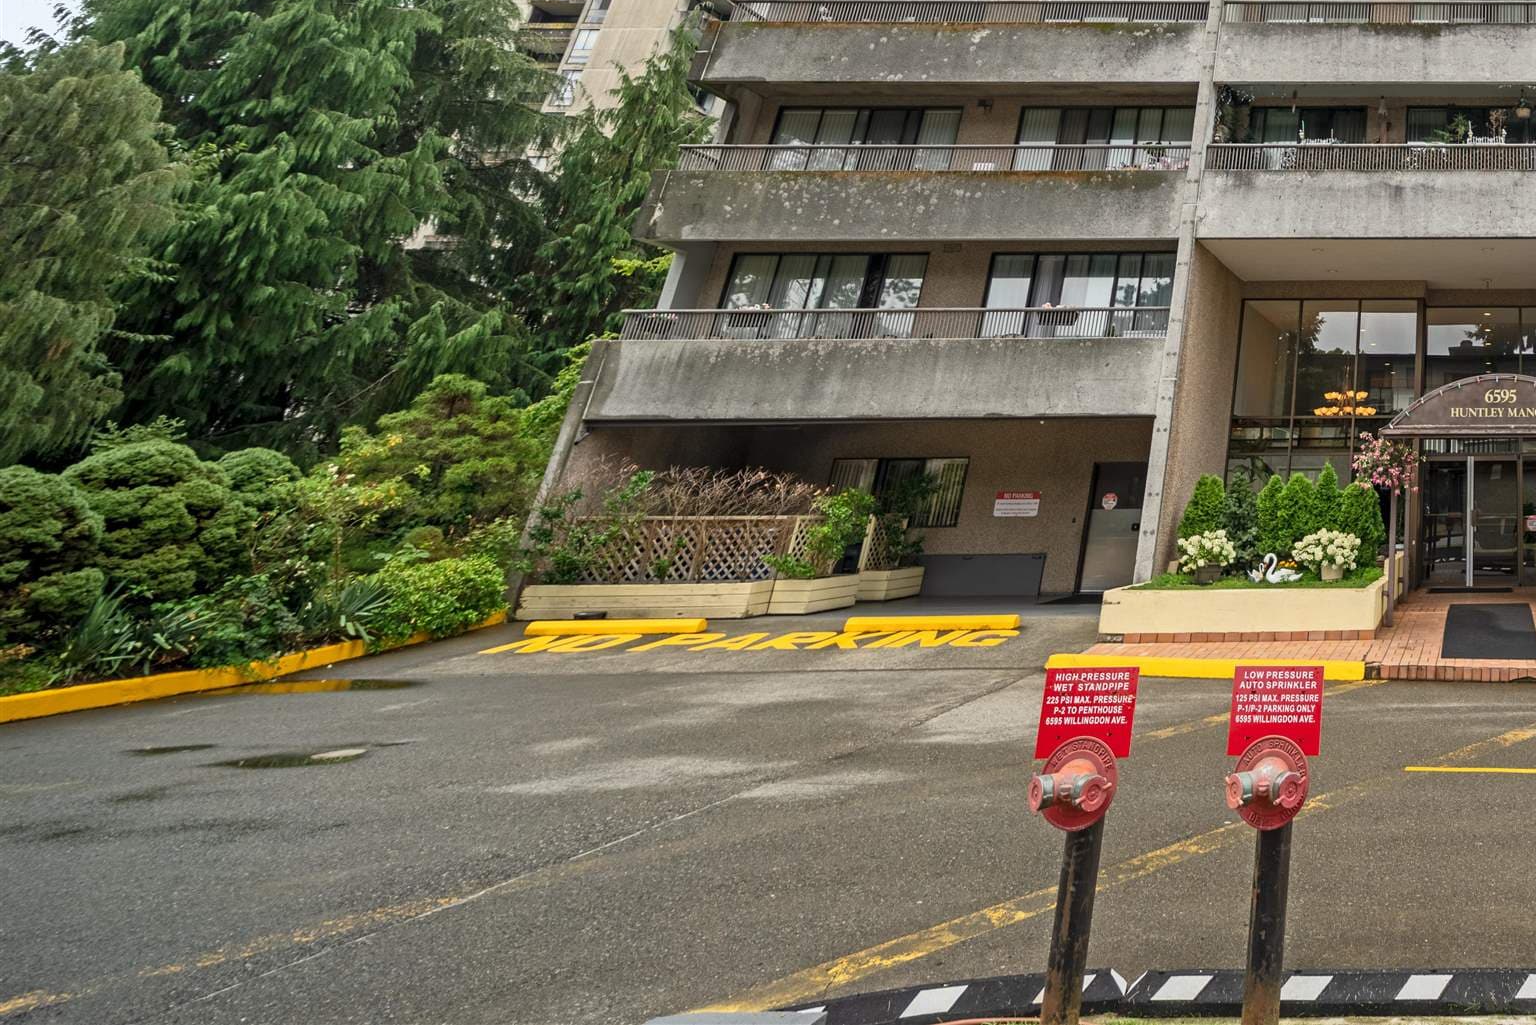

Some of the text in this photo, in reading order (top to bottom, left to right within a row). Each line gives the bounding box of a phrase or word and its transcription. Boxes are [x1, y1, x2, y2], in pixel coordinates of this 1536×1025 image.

[1484, 388, 1517, 404] 6595
[1450, 407, 1504, 418] HUNTLEY
[478, 630, 1020, 654] NO PARKING
[1055, 672, 1130, 681] HIGH PRESSURE
[1244, 671, 1314, 679] LOW PRESSURE
[1053, 682, 1130, 692] WET STANDPIPE
[1240, 681, 1317, 689] AUTO SPRINKLER
[1046, 695, 1133, 704] 225 PSI MAX. PRESSURE
[1236, 694, 1319, 702] 125 PSI MAX. PRESSURE
[1053, 705, 1123, 715] P-2 TO PENTHOUSE
[1237, 704, 1316, 713] P-1/P-2 PARKING ONLY
[1045, 716, 1128, 726] 6595 WILLINGDON AVE.
[1235, 715, 1316, 723] 6595 WILLINGDON AVE.
